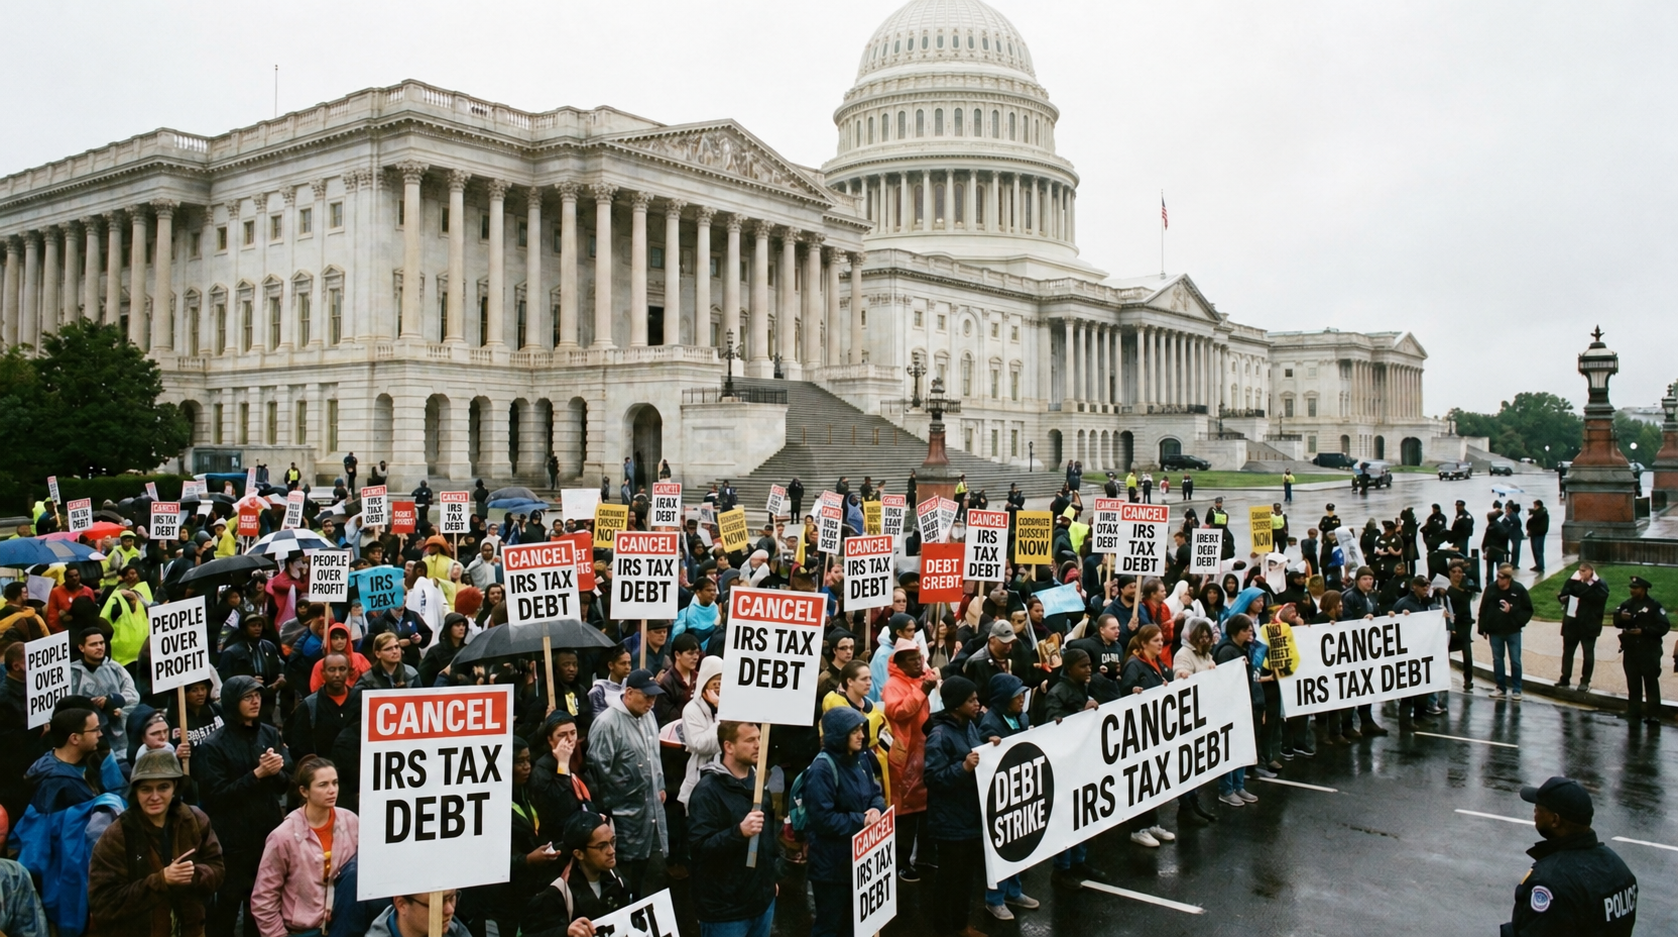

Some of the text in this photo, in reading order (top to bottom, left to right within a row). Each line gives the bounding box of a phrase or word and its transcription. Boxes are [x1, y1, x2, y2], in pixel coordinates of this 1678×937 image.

[656, 511, 676, 521] DEBT
[970, 512, 1006, 527] CANCEL
[1124, 506, 1165, 521] CANCEL
[155, 526, 175, 536] DEBT
[597, 529, 615, 541] NO
[978, 530, 997, 543] IRS
[1097, 536, 1118, 547] DEBT
[1133, 524, 1155, 538] IRS
[619, 537, 674, 553] CANCEL
[848, 537, 890, 555] CANCEL
[974, 546, 998, 561] TAX
[1019, 540, 1049, 555] NOW
[1129, 541, 1155, 556] TAX
[313, 555, 347, 567] PEOPLE
[508, 545, 570, 568] CANCEL
[618, 558, 673, 576] IRS TAX
[848, 557, 890, 576] IRS TAX
[926, 558, 959, 573] DEBT
[1123, 557, 1158, 572] DEBT
[1197, 557, 1217, 566] DEBT
[317, 570, 341, 581] OVER
[969, 563, 1001, 578] DEBT
[312, 583, 344, 594] PROFIT
[370, 574, 393, 592] IRS
[510, 570, 573, 594] IRS TAX
[620, 581, 670, 603] DEBT
[851, 576, 888, 600] DEBT
[518, 593, 570, 621] DEBT
[737, 595, 817, 623] CANCEL
[153, 606, 203, 634] PEOPLE
[161, 631, 197, 655] OVER
[734, 625, 816, 656] IRS TAX
[1320, 622, 1408, 667] CANCEL
[28, 643, 67, 670] PEOPLE
[156, 650, 204, 680] PROFIT
[35, 666, 64, 690] OVER
[738, 657, 805, 690] DEBT
[1296, 656, 1434, 706] IRS TAX DEBT
[376, 699, 501, 736] CANCEL
[1101, 684, 1207, 765] CANCEL
[373, 744, 502, 791] IRS TAX
[1072, 723, 1233, 831] IRS TAX DEBT
[995, 755, 1045, 813] DEBT
[385, 792, 490, 844] DEBT
[994, 799, 1045, 849] STRIKE
[856, 815, 892, 855] CANCEL
[857, 842, 893, 890] IRS TAX
[860, 872, 891, 923] DEBT
